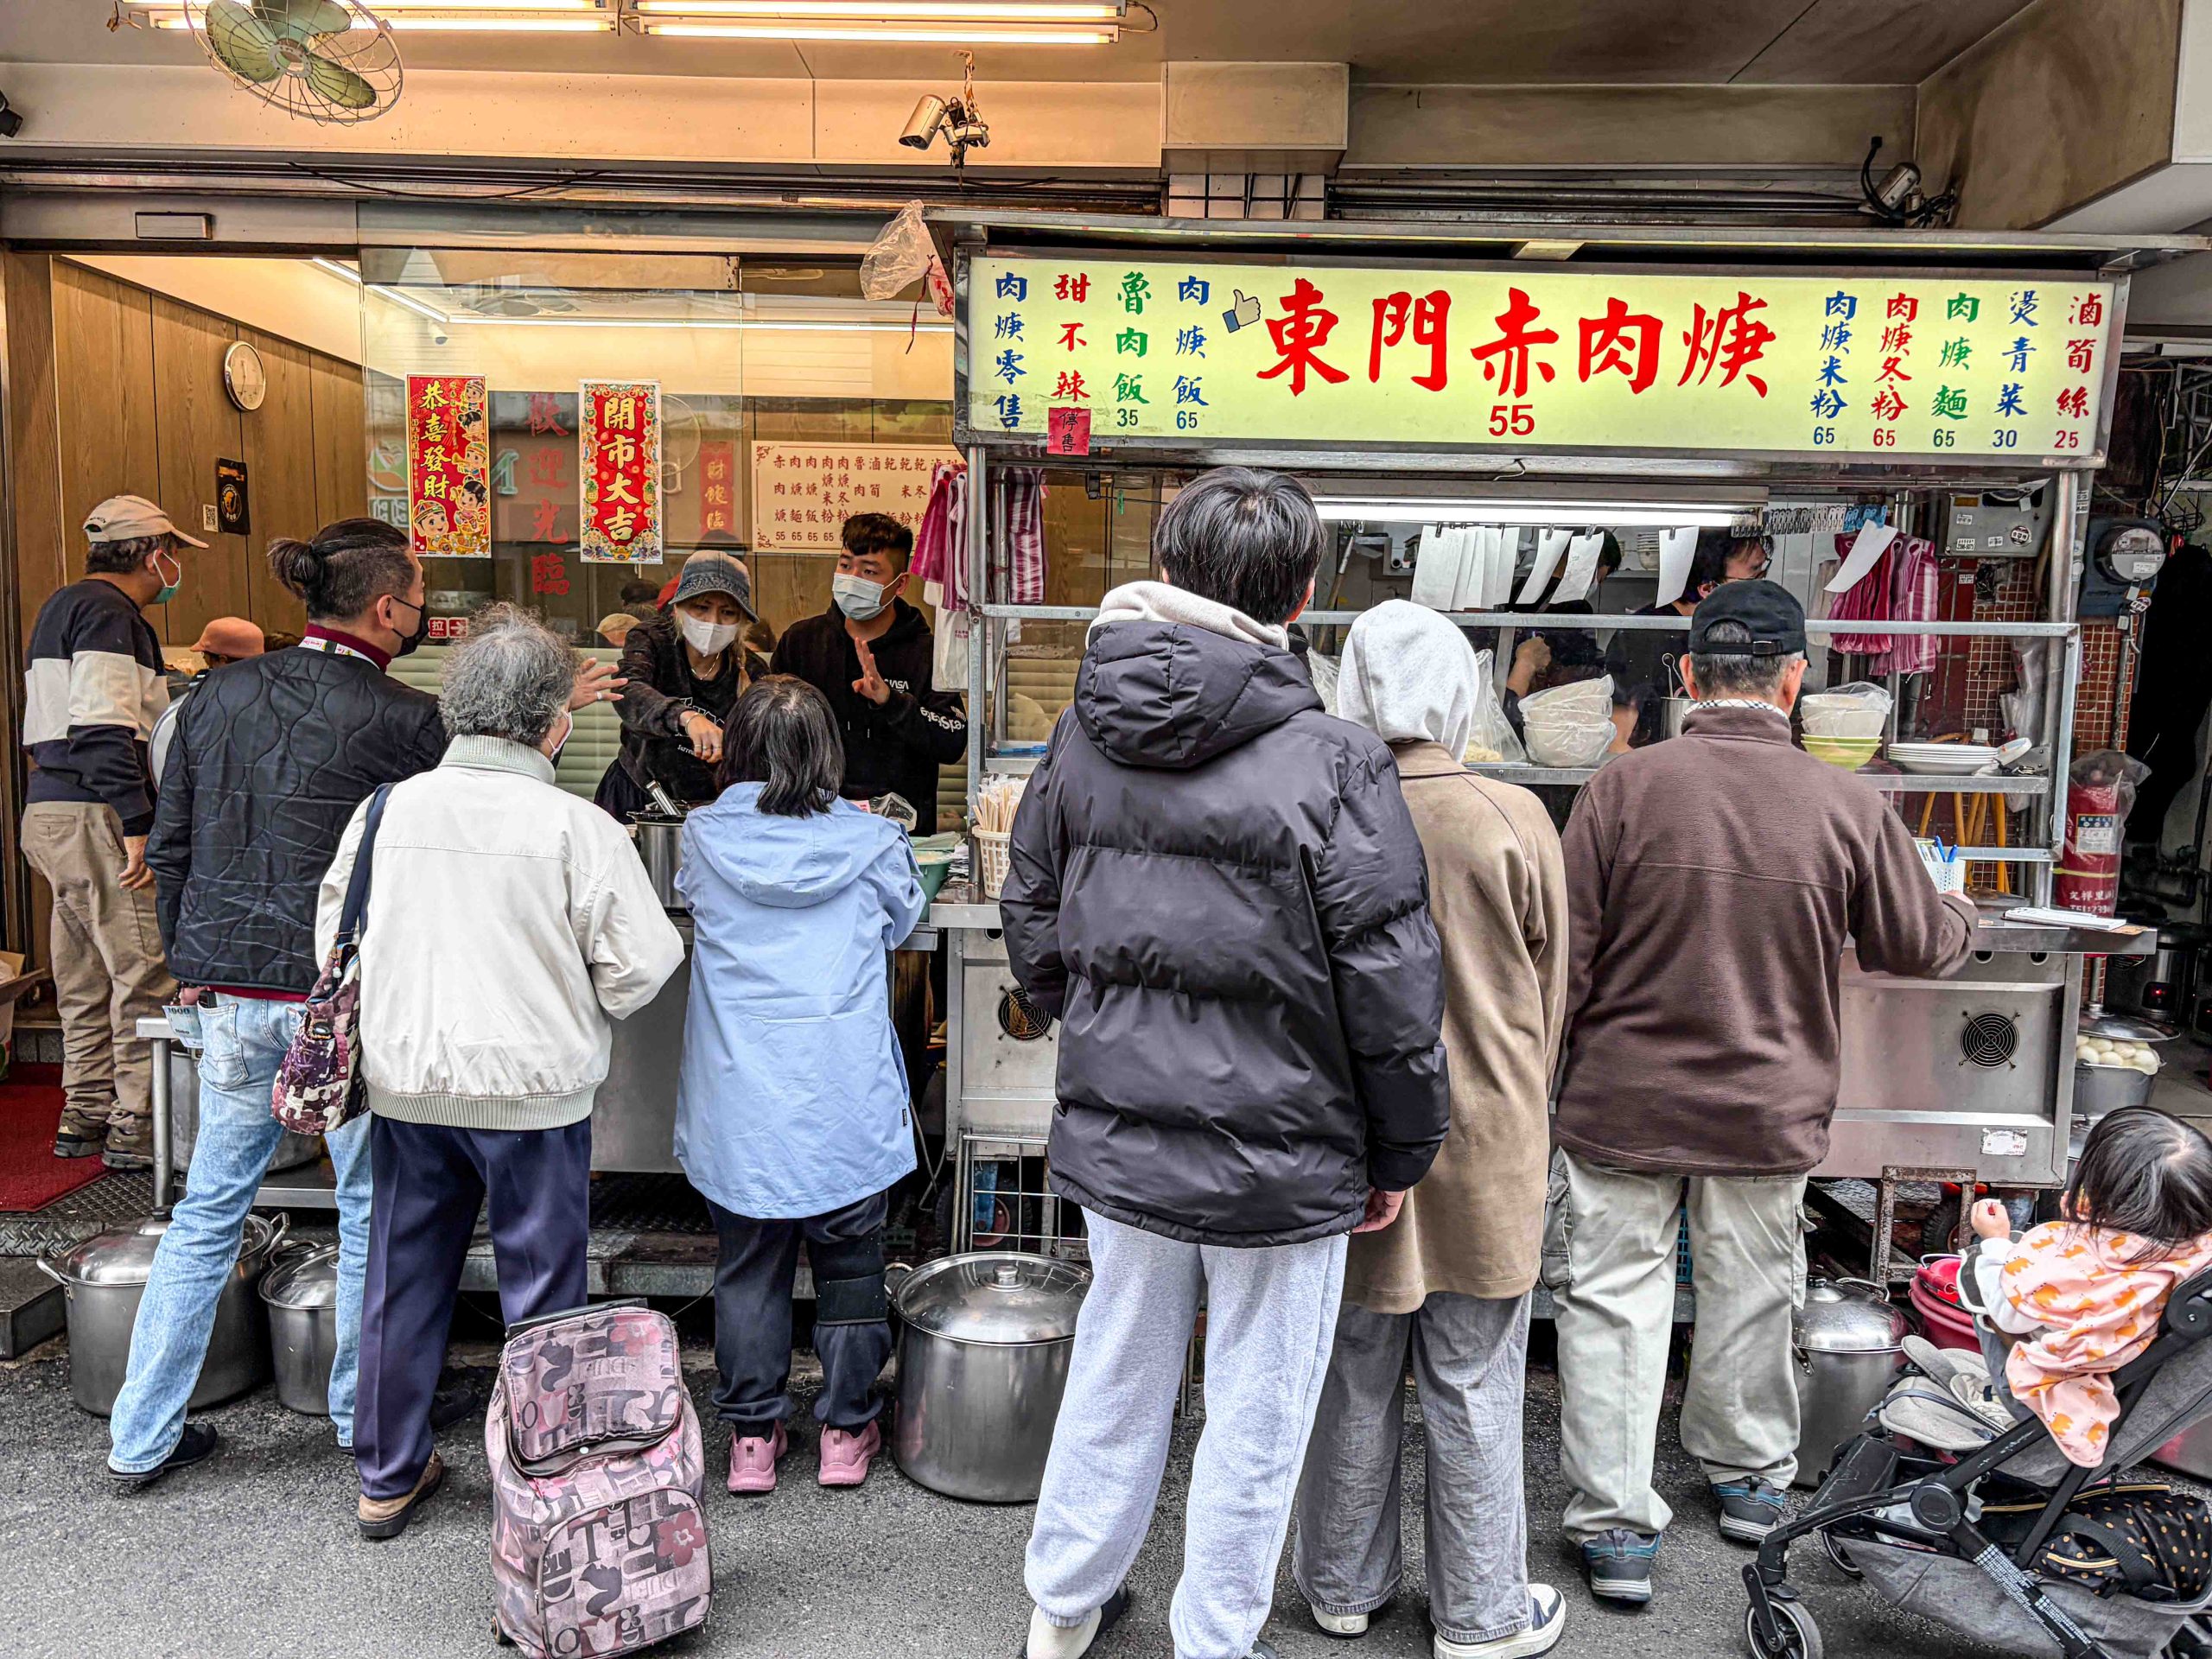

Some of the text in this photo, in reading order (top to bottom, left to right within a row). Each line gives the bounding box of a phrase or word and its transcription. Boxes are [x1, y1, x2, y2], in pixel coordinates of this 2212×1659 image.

[994, 272, 1028, 429] 肉焿零售
[1051, 273, 1090, 401] 甜不辣
[1112, 271, 1152, 428] 魯肉飯 35
[1171, 275, 1211, 429] 肉焿飯 65
[1257, 277, 1777, 398] 東門赤肉焿
[1810, 290, 1858, 445] 肉焿米粉 65
[1871, 292, 1919, 447] 肉焿冬粉 65
[1932, 292, 1980, 448] 肉焿麵 65
[1992, 289, 2040, 448] 燙青菜 30
[2054, 292, 2101, 448] 滷筍絲 25
[419, 380, 451, 499] 恭喜發財
[601, 397, 640, 541] 開市大吉
[1058, 411, 1078, 453] 停售
[1488, 404, 1535, 436] 55
[775, 531, 785, 541] 55
[791, 532, 802, 542] 65
[808, 532, 818, 542] 65
[823, 532, 834, 542] 65
[899, 457, 912, 526] 乾米粉
[432, 621, 444, 631] 拉
